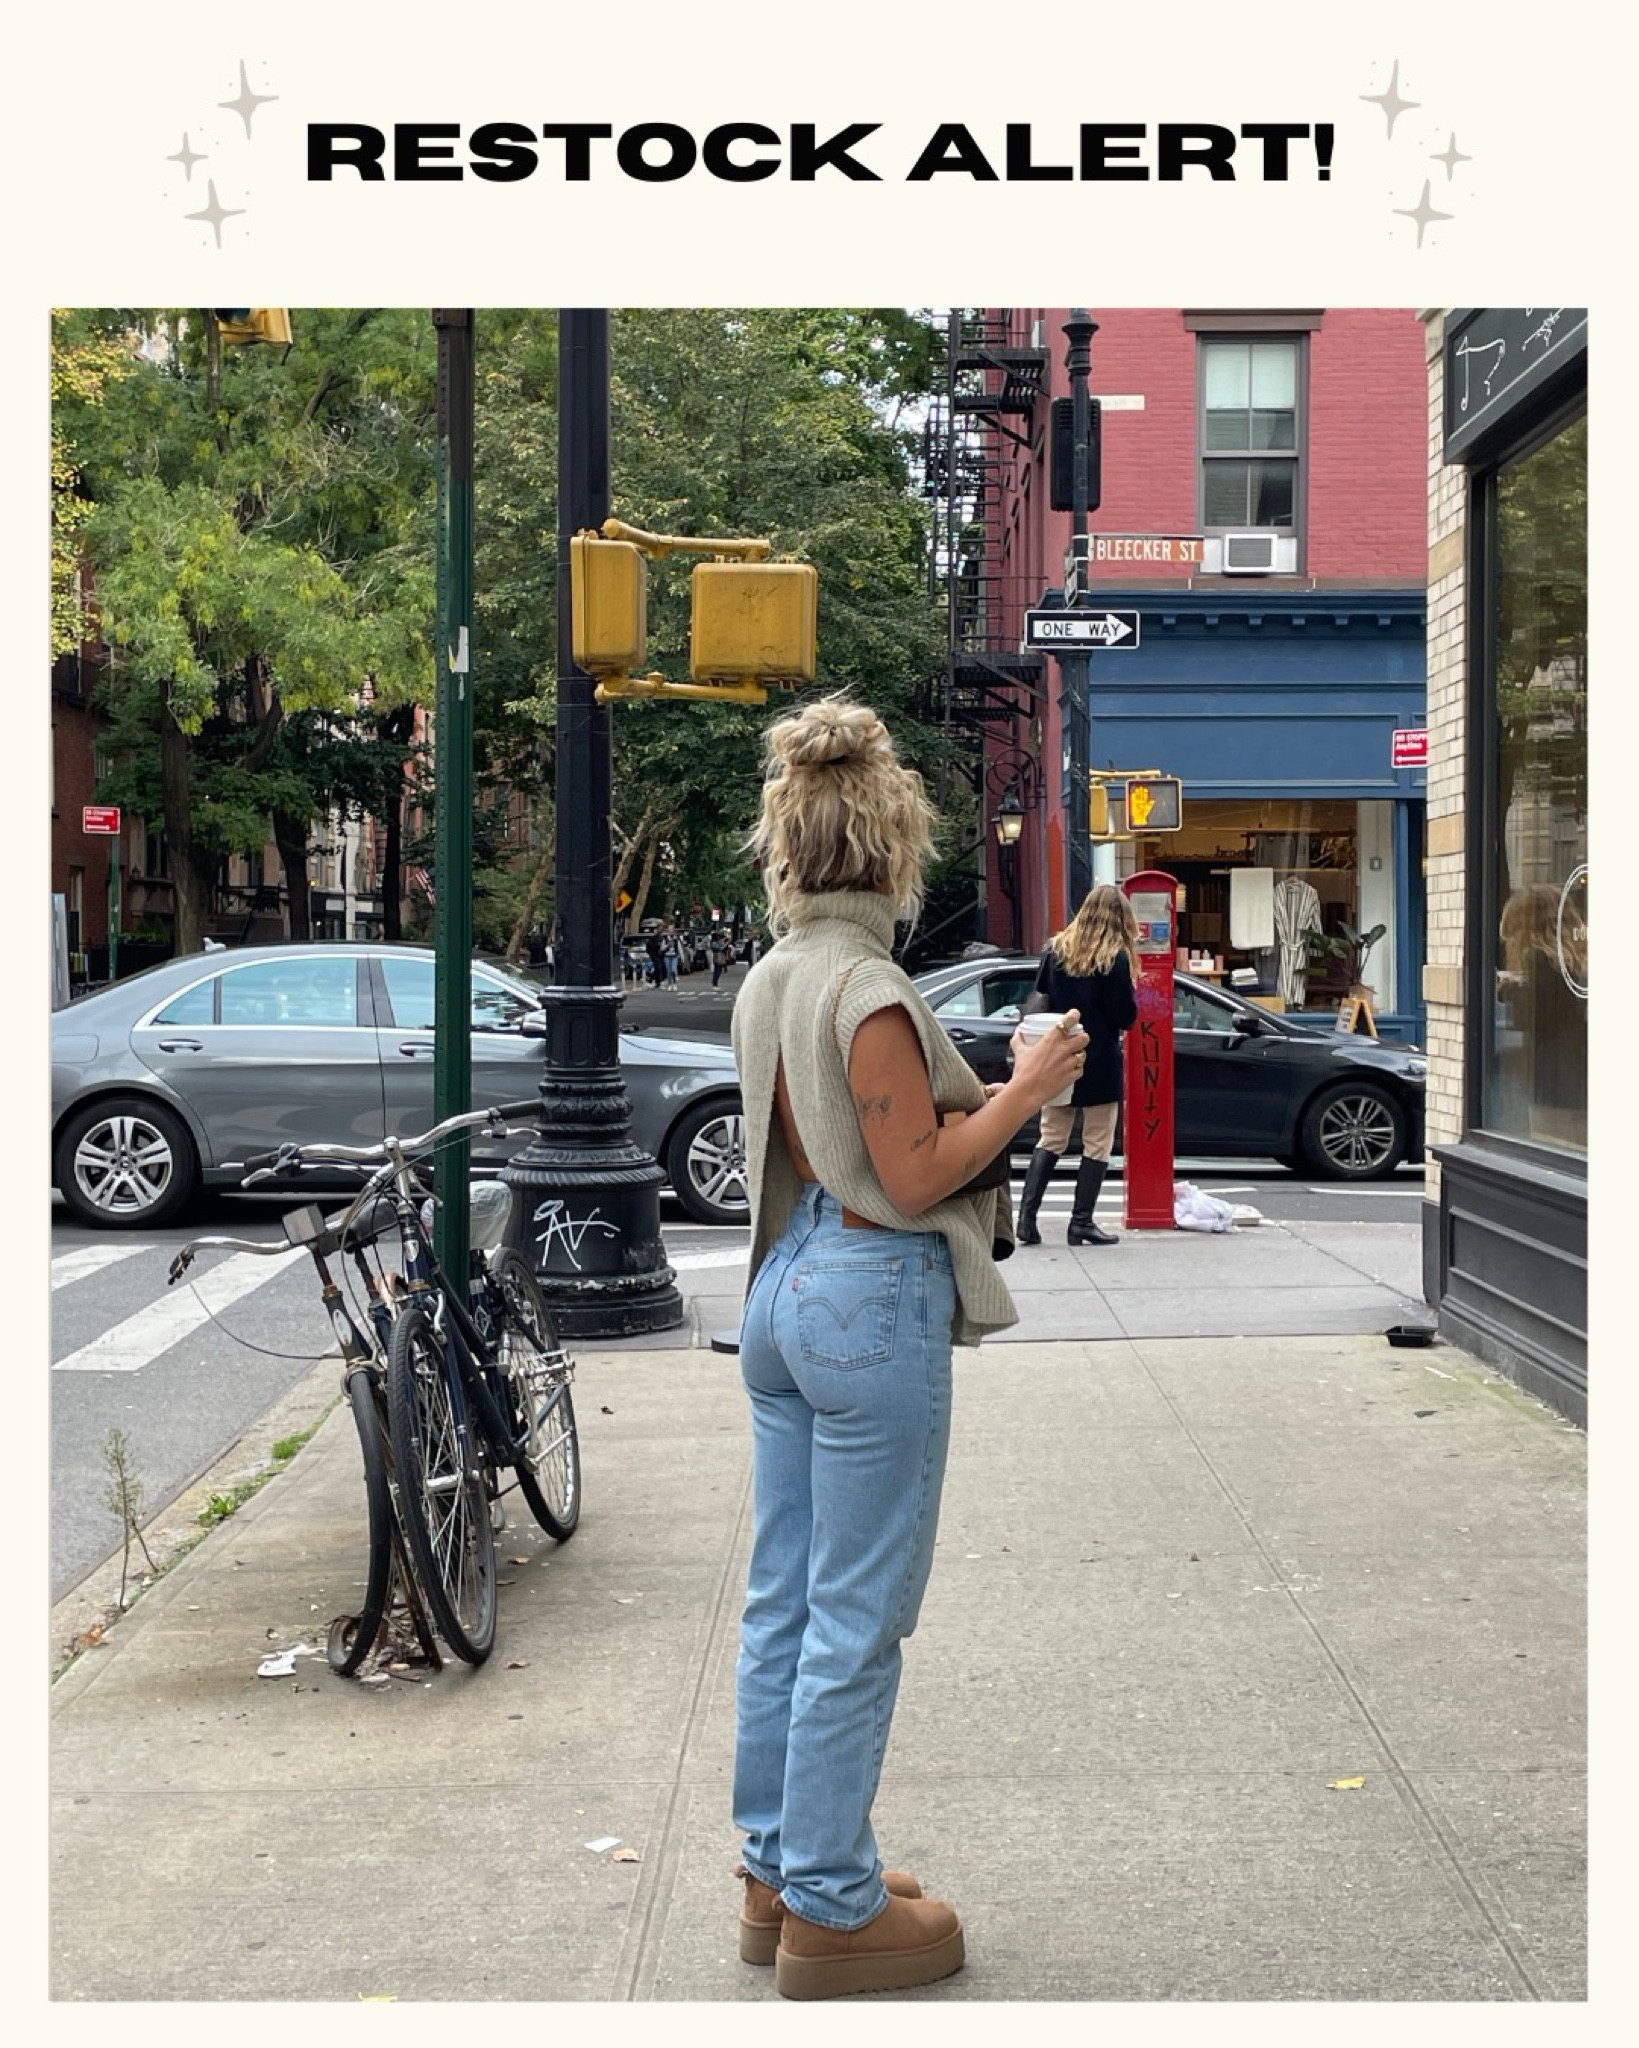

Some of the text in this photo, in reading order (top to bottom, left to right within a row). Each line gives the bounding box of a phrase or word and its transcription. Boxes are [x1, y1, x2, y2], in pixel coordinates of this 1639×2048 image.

[1096, 540, 1198, 561] BLEECKER ST
[1042, 622, 1121, 637] ONE WAY
